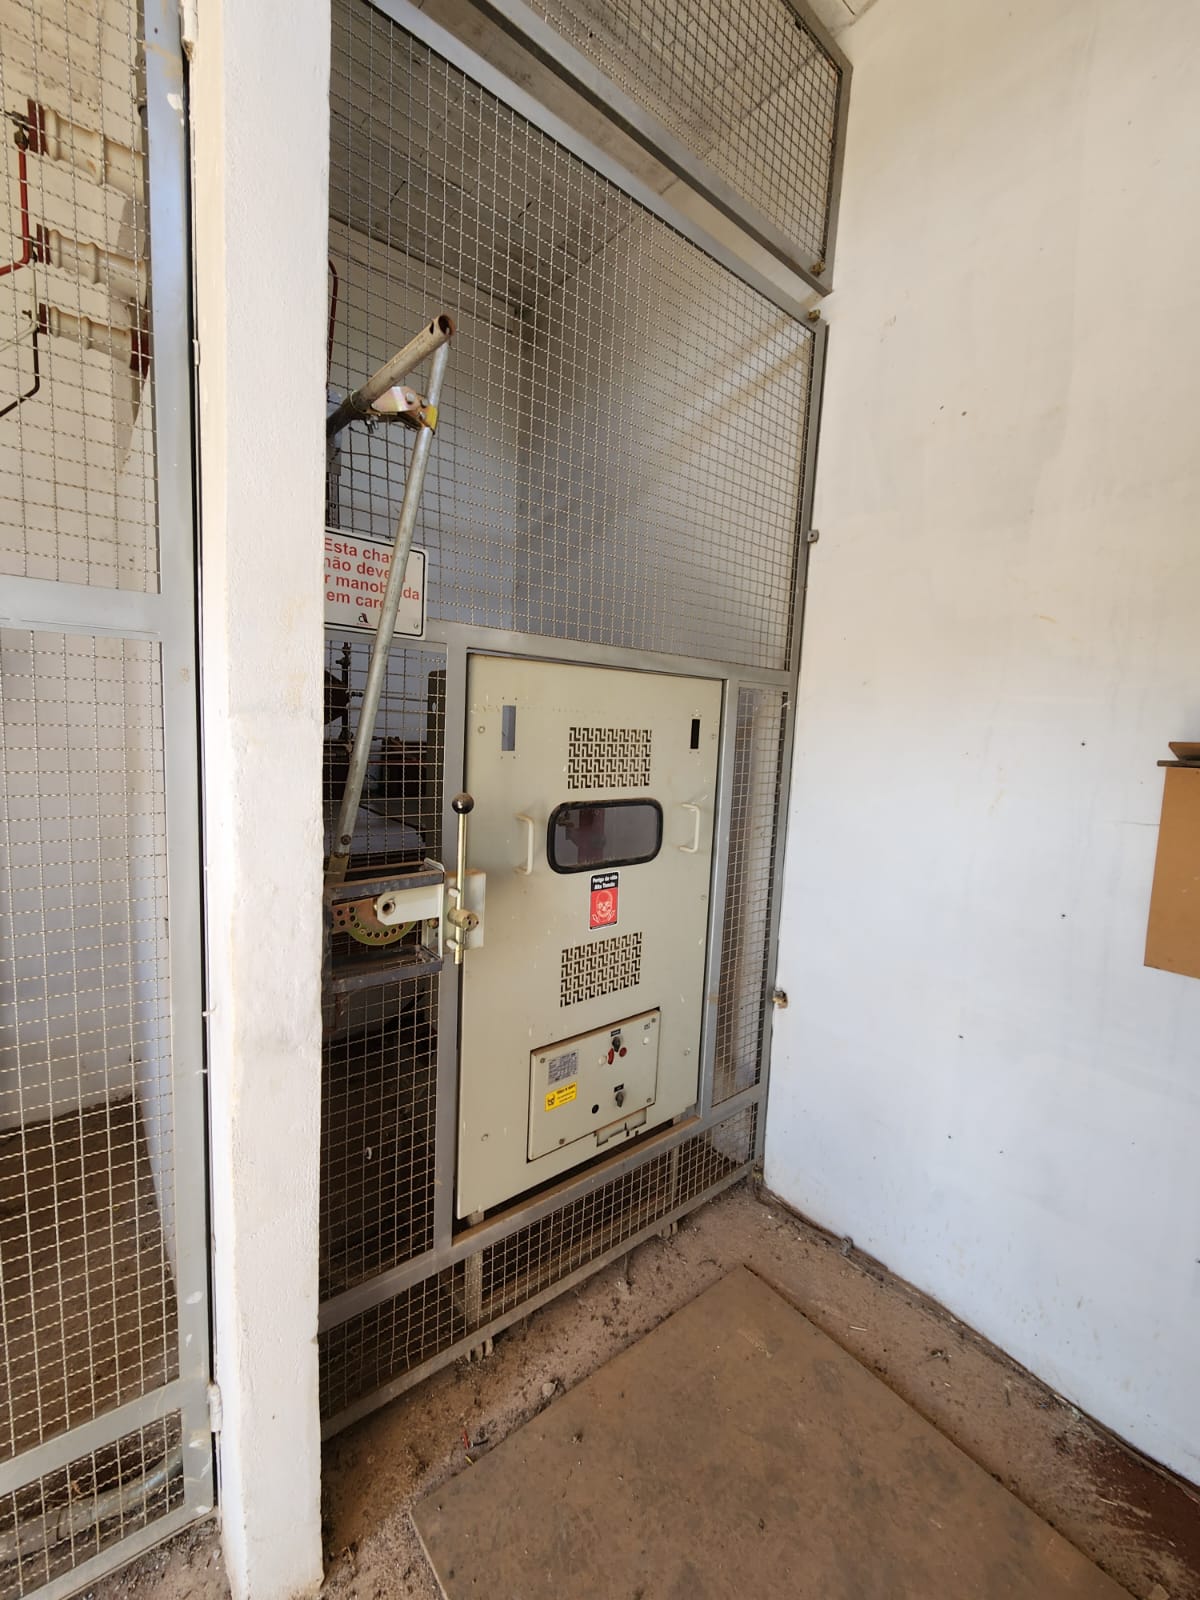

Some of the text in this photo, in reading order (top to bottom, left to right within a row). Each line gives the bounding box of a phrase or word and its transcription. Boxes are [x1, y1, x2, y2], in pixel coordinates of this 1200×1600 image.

[325, 537, 394, 564] Esta cha
[357, 562, 406, 582] deve
[336, 576, 419, 600] manobda
